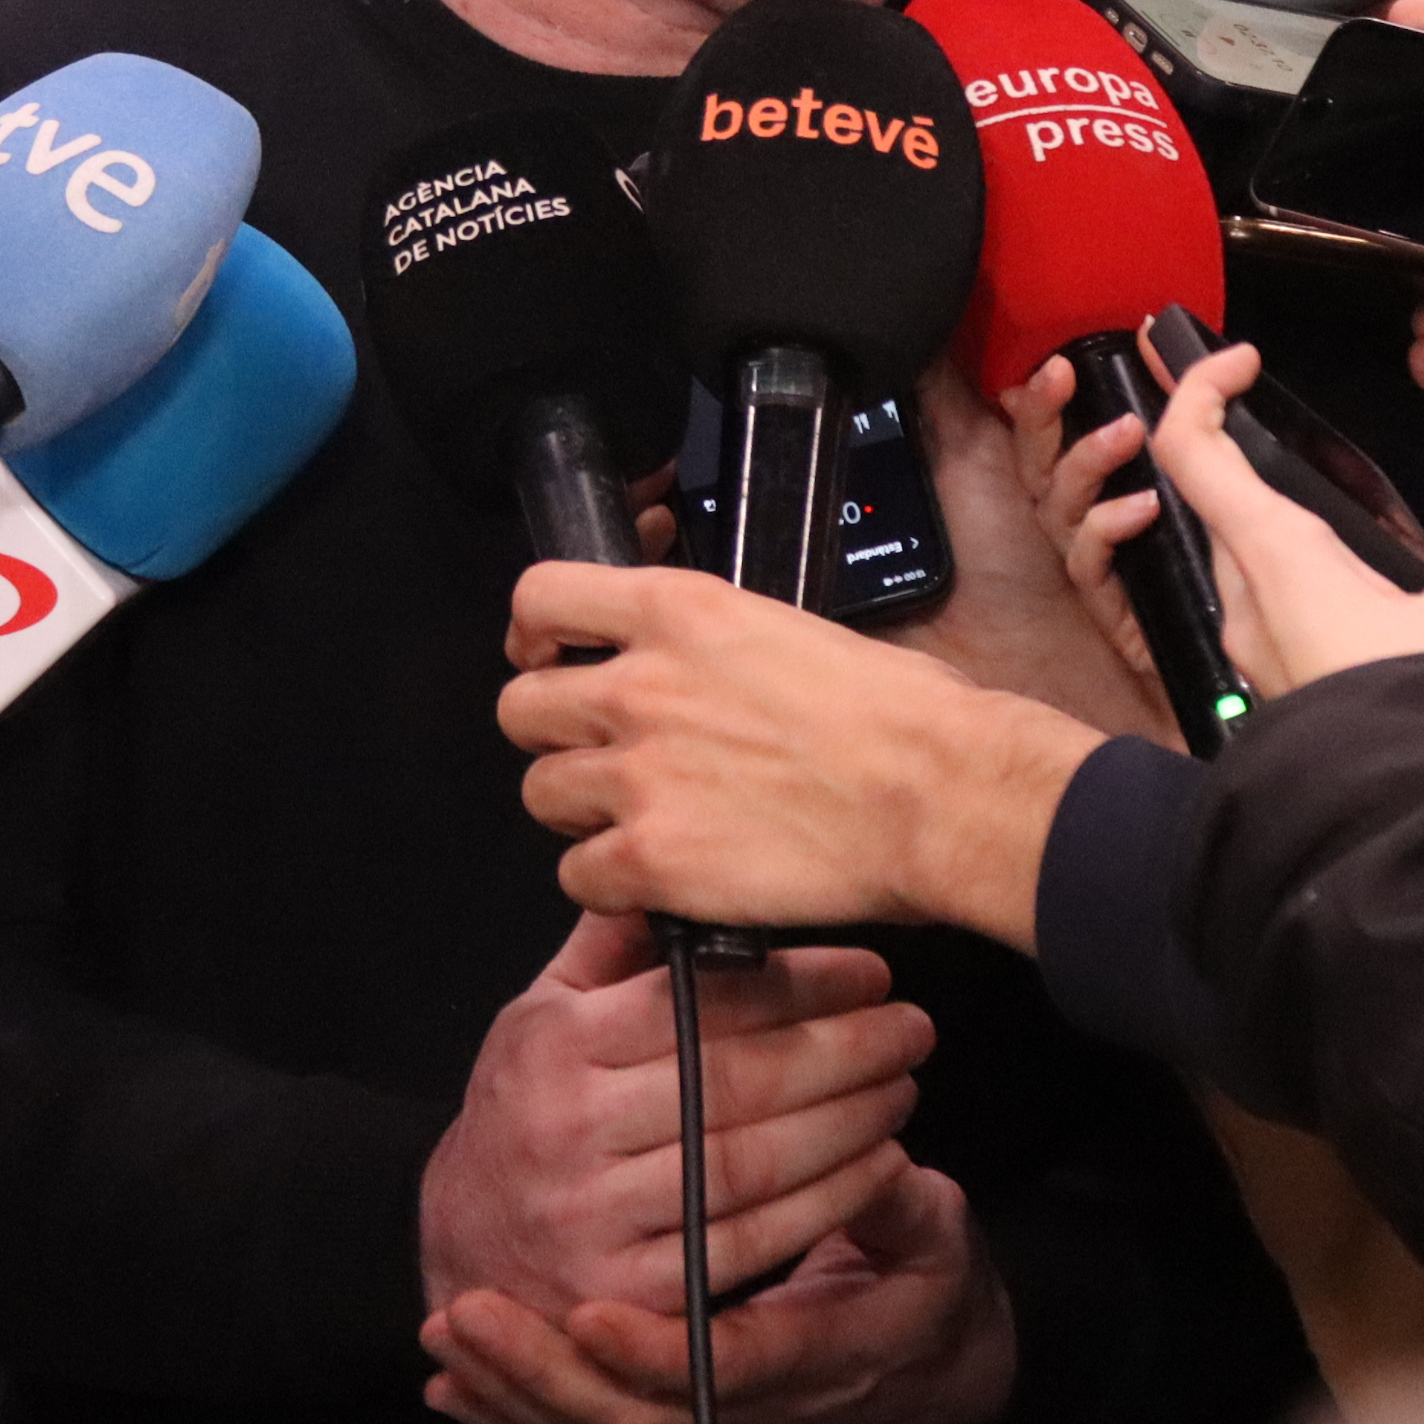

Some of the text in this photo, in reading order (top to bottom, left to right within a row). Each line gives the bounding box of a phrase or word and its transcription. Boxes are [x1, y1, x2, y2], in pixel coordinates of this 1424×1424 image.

[965, 66, 1161, 111] europa
[1026, 114, 1181, 162] press
[383, 159, 508, 228] AGÈNCIA
[388, 177, 537, 247] CATALANA
[394, 197, 572, 276] DE NOTÍCIES
